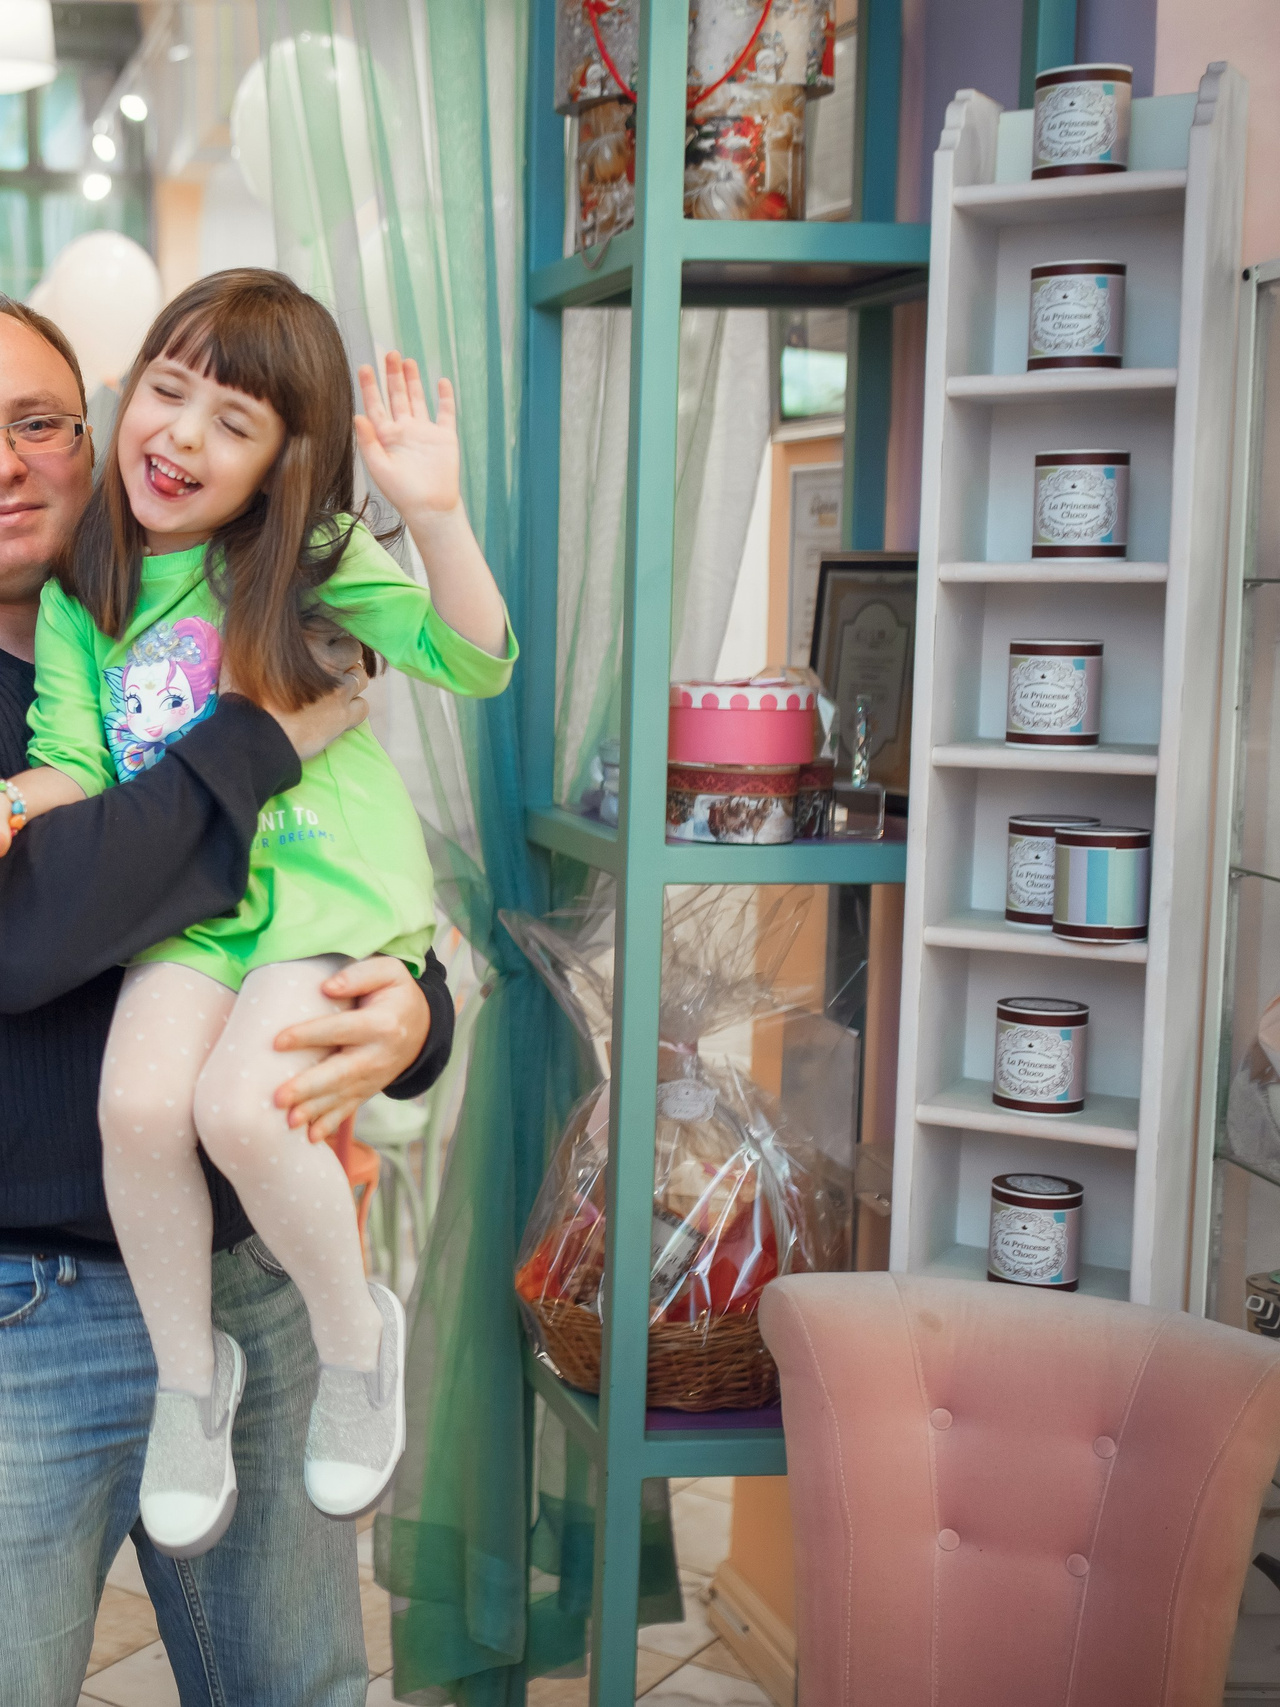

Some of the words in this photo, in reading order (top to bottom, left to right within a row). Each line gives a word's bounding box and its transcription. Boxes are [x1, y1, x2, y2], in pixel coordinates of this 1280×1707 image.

[1048, 502, 1059, 510] La
[1060, 501, 1101, 510] Princesse
[1061, 510, 1088, 519] Choco
[1020, 691, 1029, 699] La
[1030, 691, 1070, 700] Princesse
[1031, 700, 1057, 709] Choco
[257, 809, 286, 832] NT
[293, 806, 319, 825] TO
[279, 829, 336, 846] DREAMS
[1006, 1057, 1017, 1065] La
[1017, 1058, 1057, 1069] Princesse
[1018, 1067, 1045, 1078] Choco
[1000, 1237, 1011, 1246] La
[1011, 1240, 1051, 1252] Princesse
[1012, 1249, 1038, 1260] Choco
